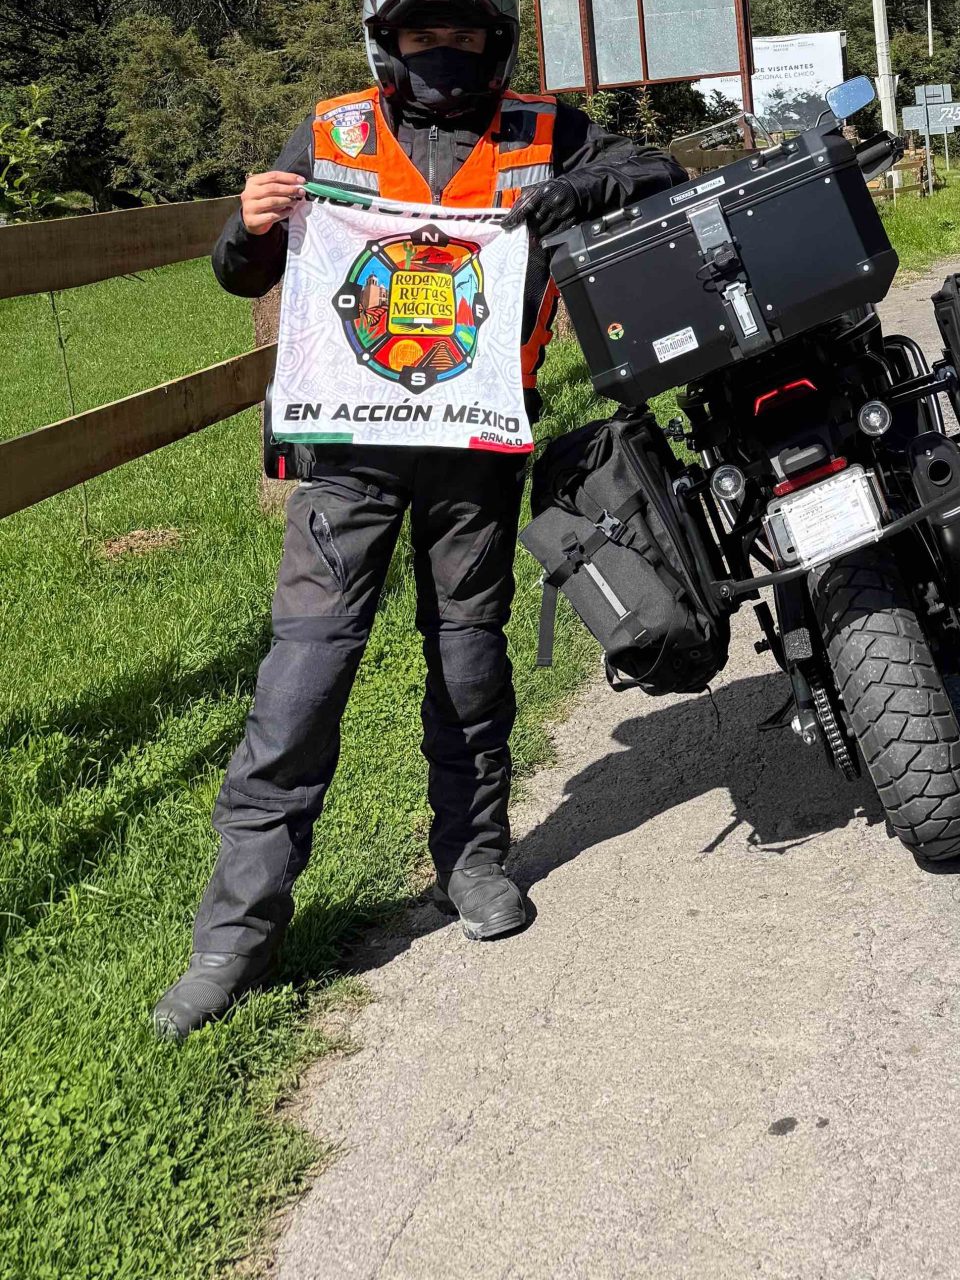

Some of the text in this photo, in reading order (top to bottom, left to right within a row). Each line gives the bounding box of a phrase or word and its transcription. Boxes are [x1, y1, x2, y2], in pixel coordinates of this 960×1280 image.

[768, 63, 814, 72] VISITANTES
[752, 73, 783, 81] ACIONAL
[421, 231, 439, 243] N
[338, 295, 356, 308] O
[475, 304, 485, 318] E
[410, 372, 426, 385] S
[284, 398, 520, 433] EN ACCIÓN MÉXICO
